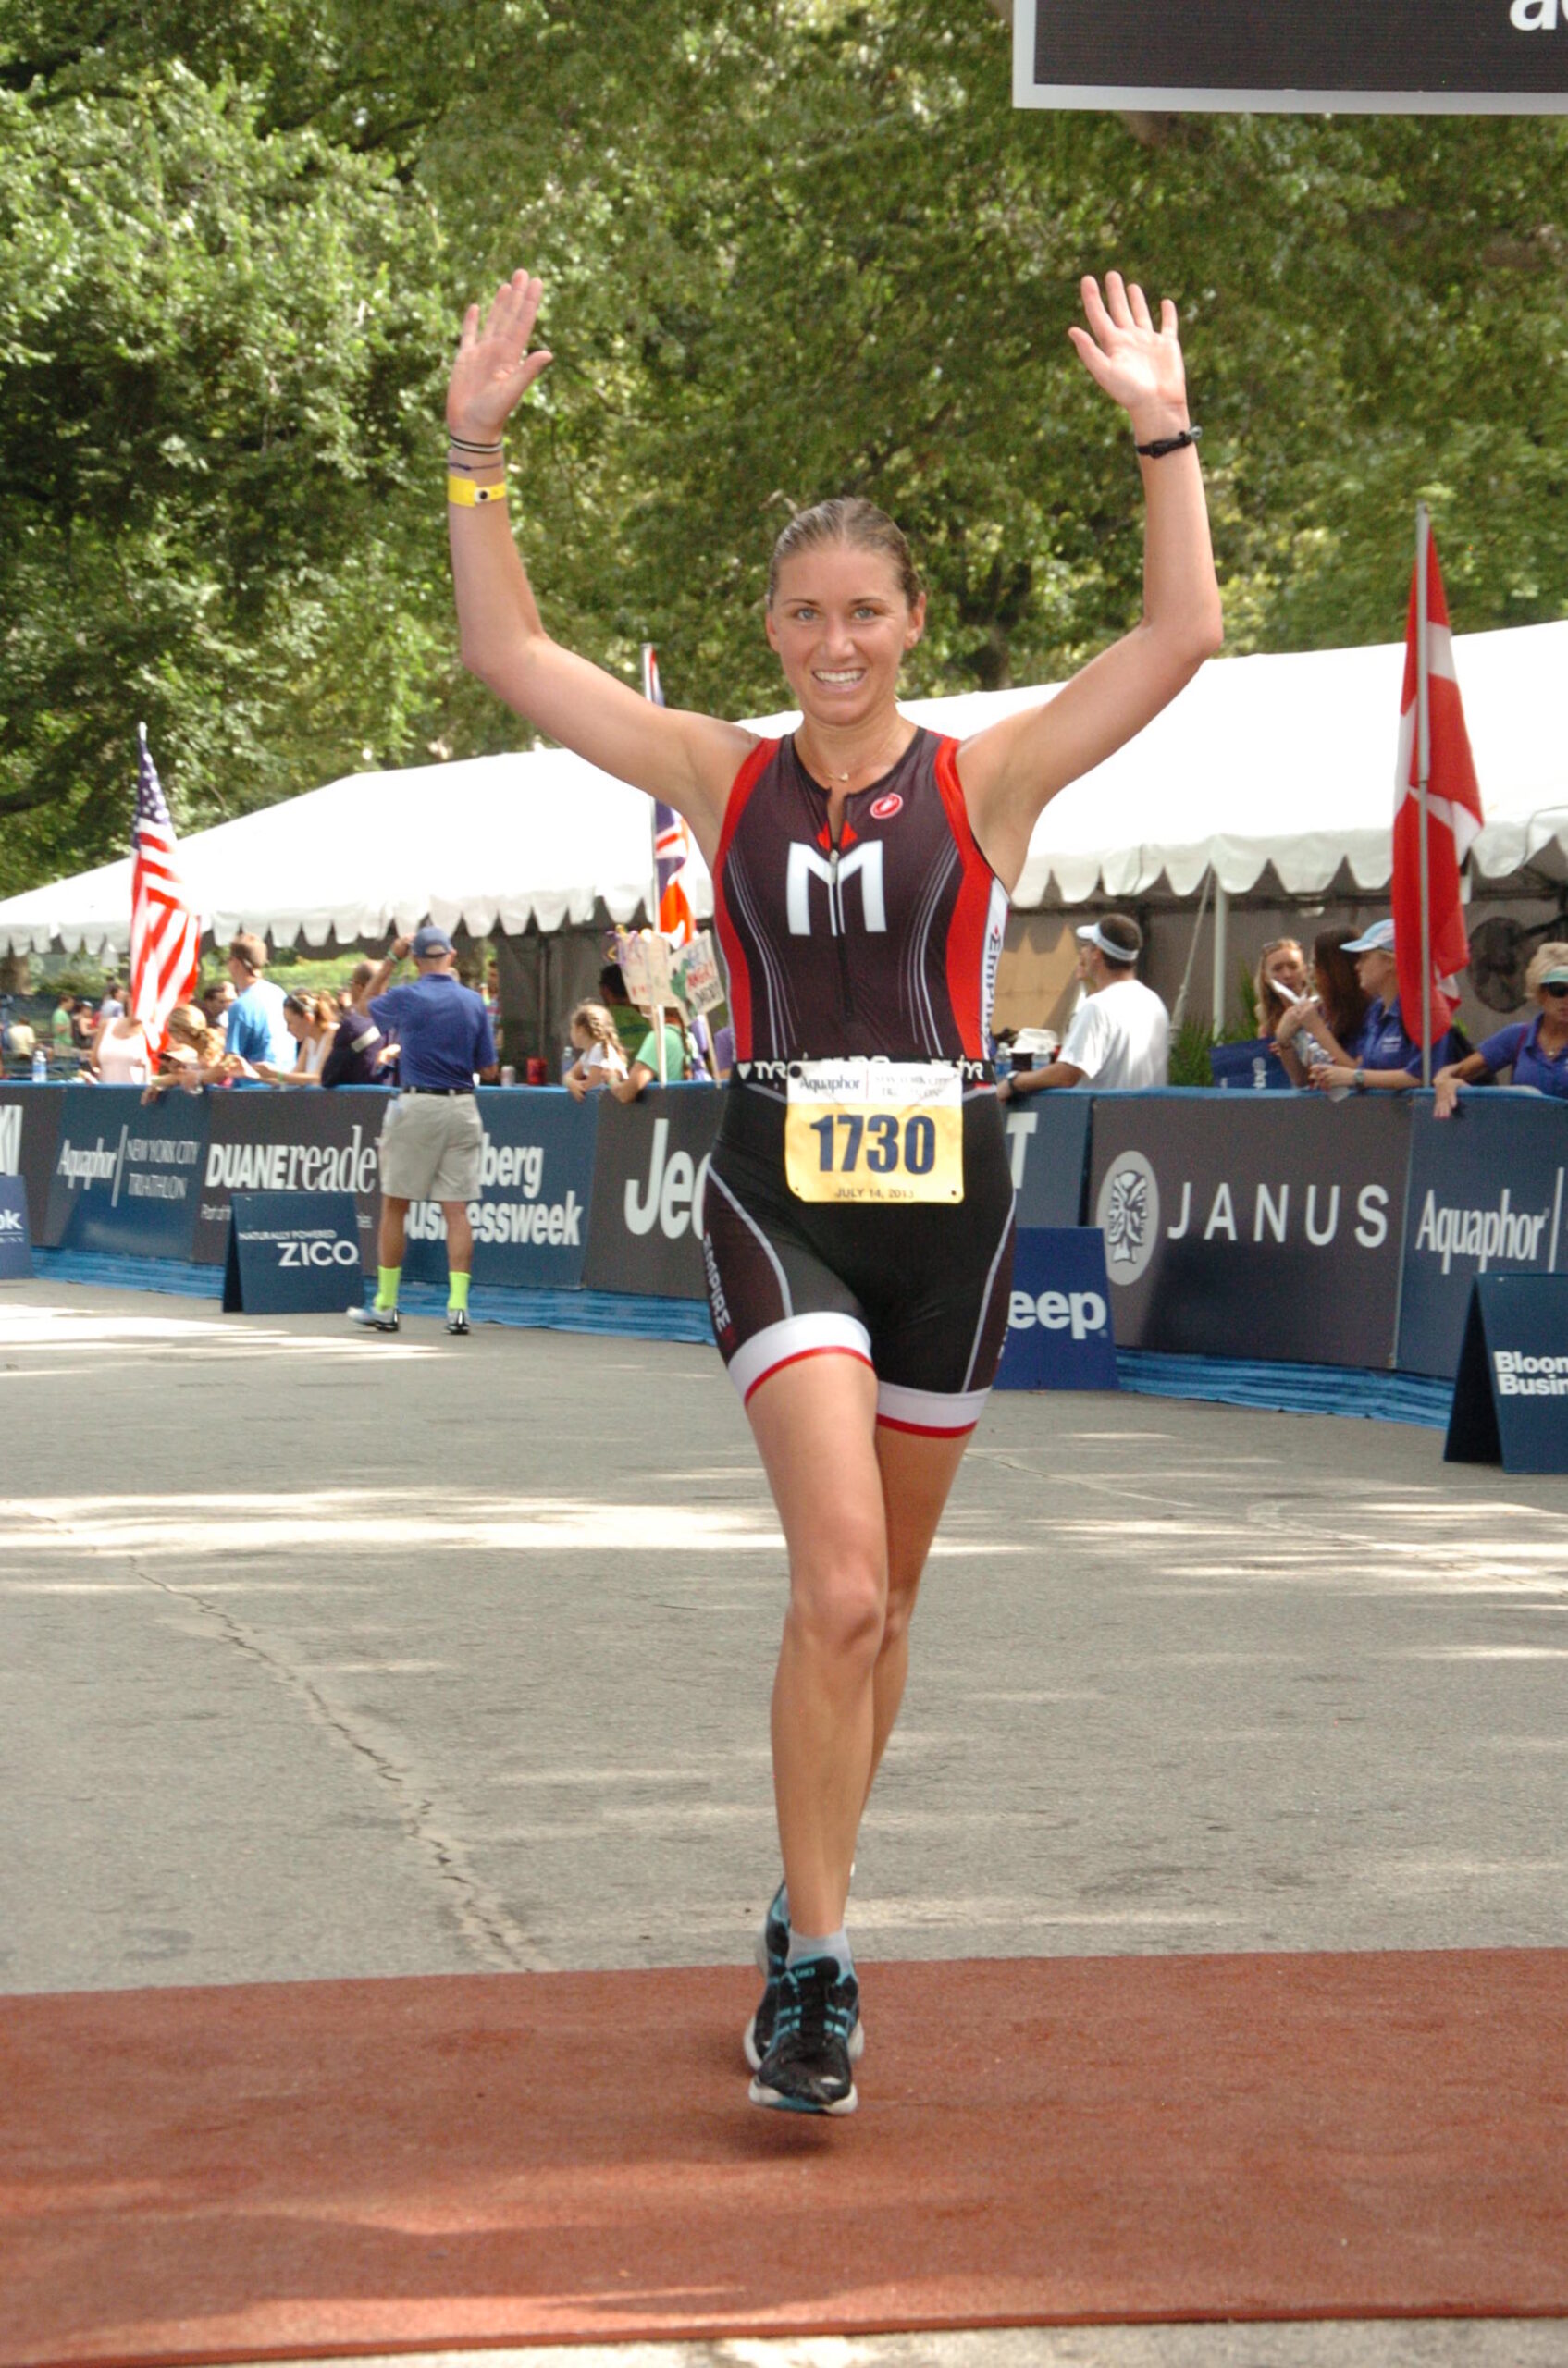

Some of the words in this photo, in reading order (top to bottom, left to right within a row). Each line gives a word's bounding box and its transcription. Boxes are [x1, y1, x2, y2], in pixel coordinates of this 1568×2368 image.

[753, 1061, 787, 1080] TYR
[799, 1074, 860, 1094] Aquaphor
[56, 1137, 117, 1190] Aquaphor
[126, 1139, 148, 1161] NEW
[149, 1140, 176, 1163] YORK
[176, 1141, 201, 1164] CITY
[478, 1132, 544, 1199] berg
[809, 1114, 936, 1176] 1730
[1006, 1112, 1038, 1189] T
[834, 1188, 865, 1199] JULY
[1167, 1182, 1389, 1248] JANUS
[238, 1231, 291, 1240] NATURALLY
[291, 1229, 337, 1240] POWERED
[277, 1240, 359, 1266] ZICO
[1415, 1189, 1547, 1275] Aquaphor
[1006, 1290, 1107, 1340] eep
